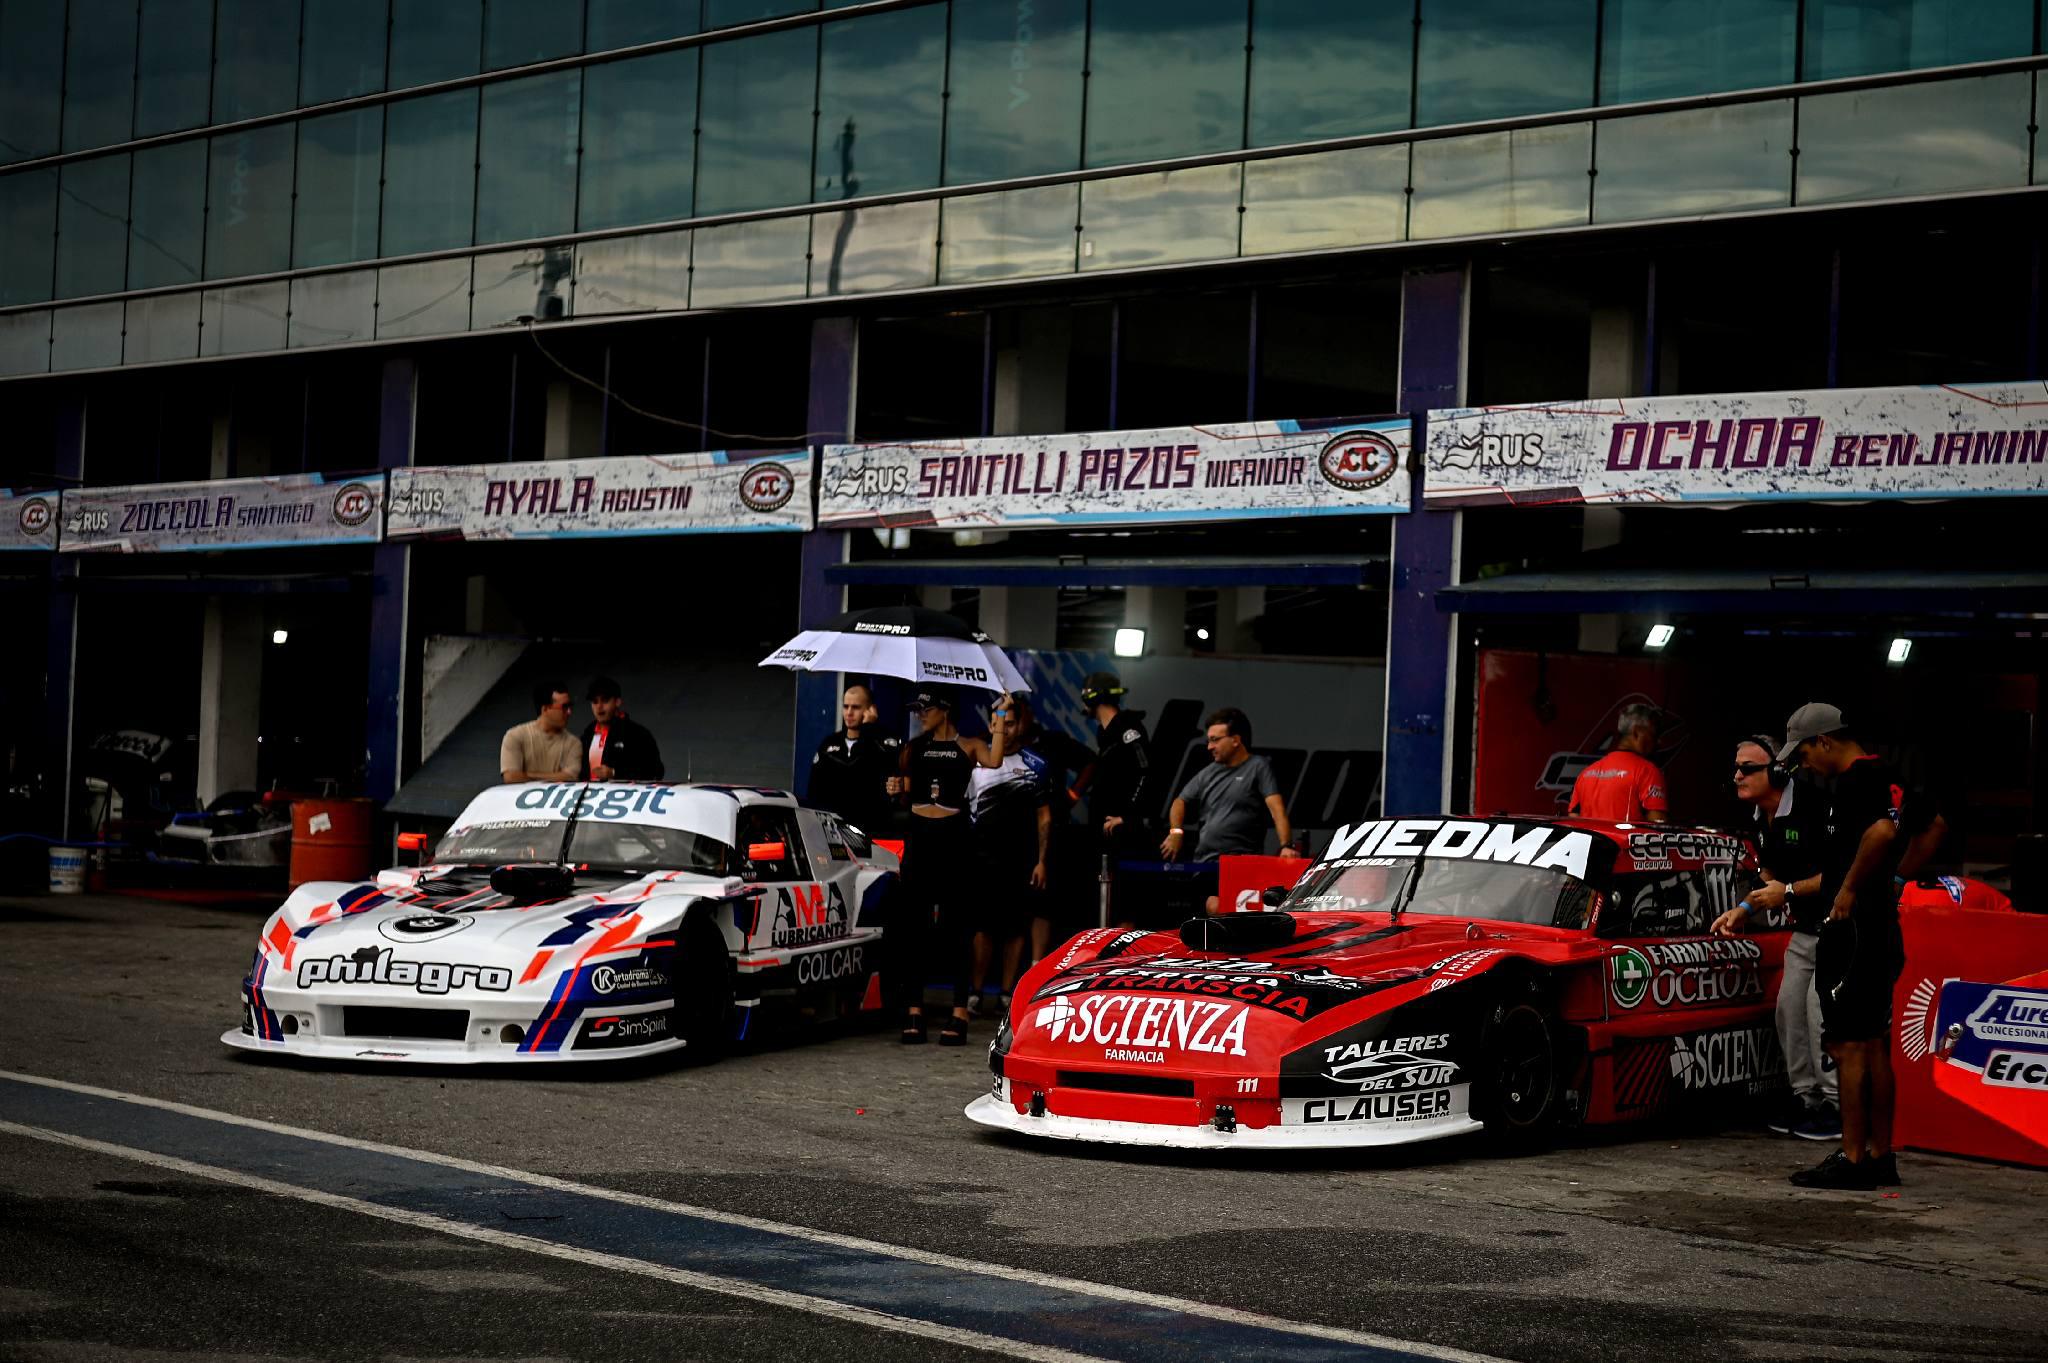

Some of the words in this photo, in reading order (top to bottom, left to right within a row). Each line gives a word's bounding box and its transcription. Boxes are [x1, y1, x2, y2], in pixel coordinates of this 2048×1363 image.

[1482, 434, 1544, 467] RUS
[1604, 416, 1823, 471] OCHOA
[1830, 430, 2048, 467] BENJAMIN
[862, 466, 908, 494] RUS
[917, 452, 1064, 497] SANTILLI
[1078, 445, 1199, 492] PAZOS
[1204, 457, 1303, 487] NICANOR
[411, 488, 444, 512] RUS
[484, 477, 594, 515] AYALA
[600, 485, 693, 514] AGUSTIN
[81, 510, 108, 531] RUS
[119, 497, 236, 532] ZOCCOLA
[237, 502, 314, 525] SANTIAGO
[954, 665, 988, 682] PRO
[515, 783, 675, 819] diggit
[1323, 819, 1592, 880] VIEDMA
[772, 882, 848, 929] AMA
[772, 920, 847, 947] LUBRICANTS
[798, 946, 863, 984] COLCAR
[1645, 939, 1761, 965] FARMACIAS
[296, 947, 512, 995] philagro
[1652, 967, 1763, 1005] OCHOA
[1088, 975, 1310, 1016] TRANSCIA
[1069, 994, 1249, 1056] SCIENZA
[1105, 1049, 1165, 1064] FARMACIA
[1324, 1034, 1450, 1062] TALLERES
[1236, 1078, 1259, 1092] 111
[1360, 1079, 1394, 1091] DEL
[1401, 1067, 1454, 1088] SUR
[1987, 1054, 2048, 1085] Erc
[1303, 1089, 1451, 1123] CLAUSER
